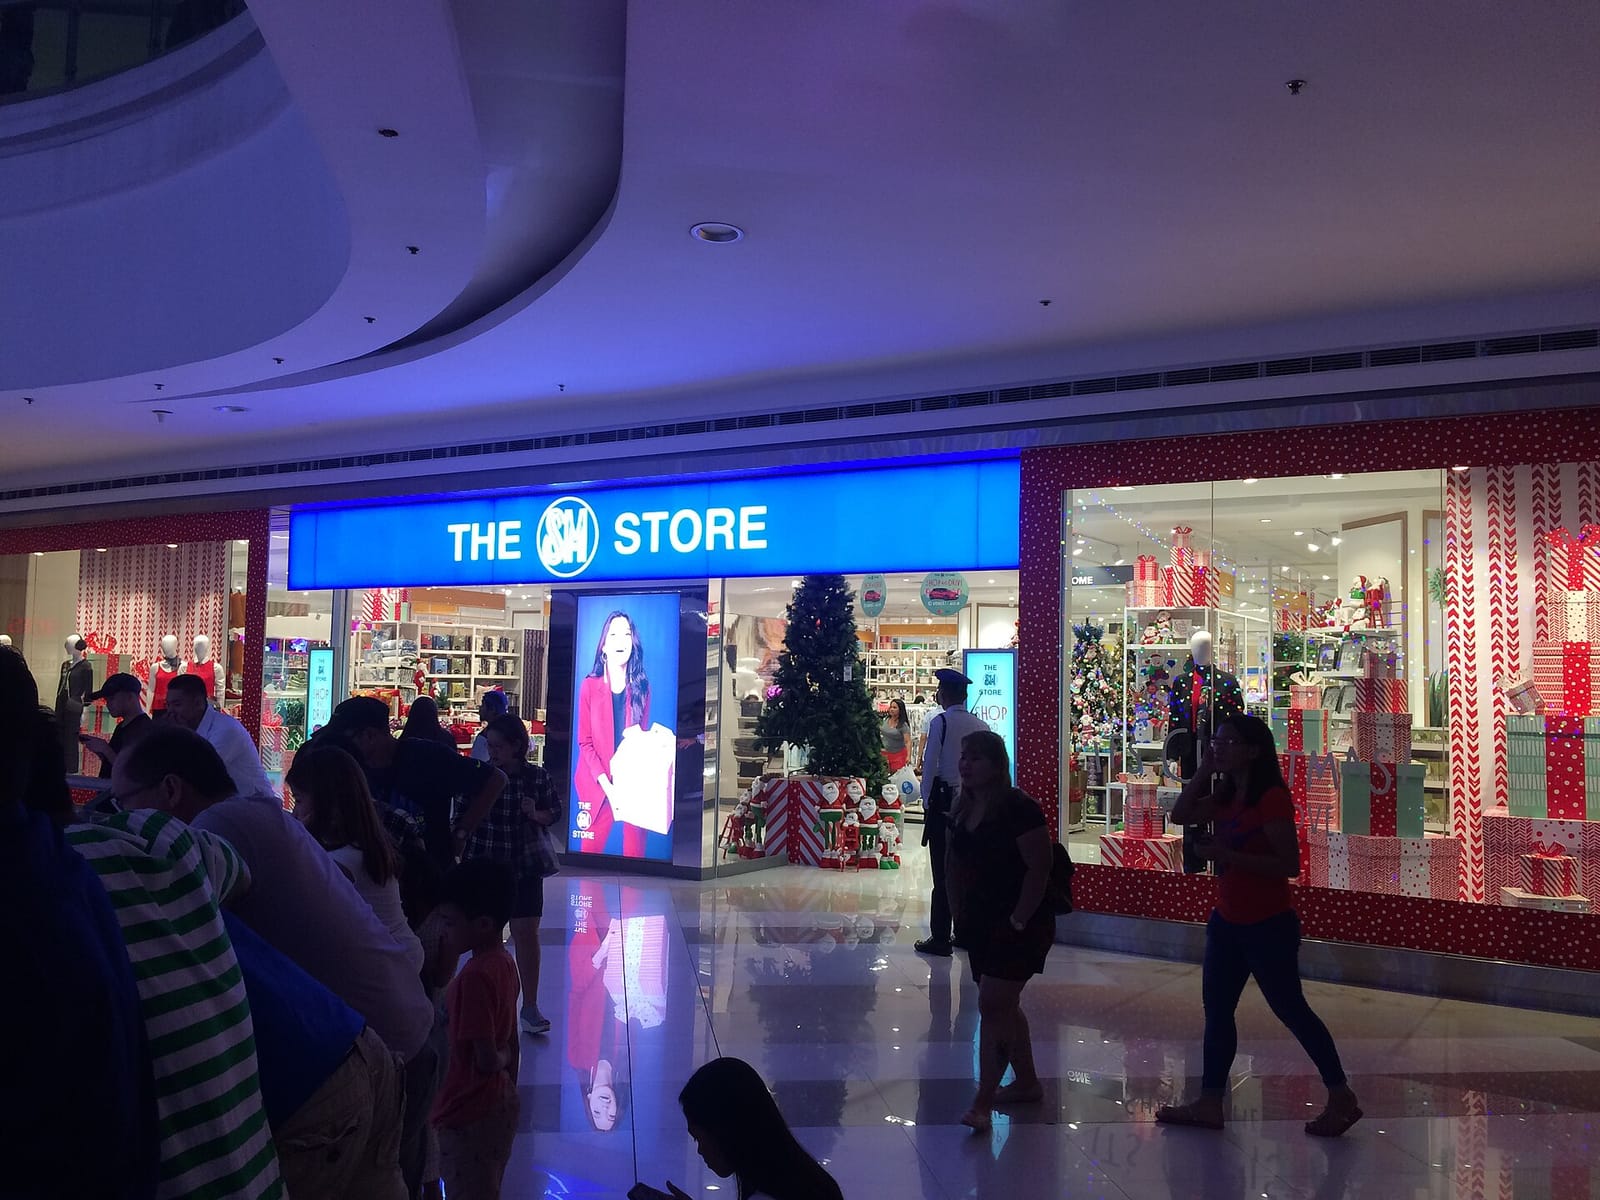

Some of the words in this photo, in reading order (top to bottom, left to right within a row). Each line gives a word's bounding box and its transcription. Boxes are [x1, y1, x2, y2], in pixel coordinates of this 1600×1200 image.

[448, 520, 522, 562] THE
[540, 504, 590, 568] SM
[613, 505, 768, 555] STORE
[1072, 576, 1094, 585] OME
[975, 705, 1008, 720] SHOP
[577, 801, 593, 810] THE
[572, 830, 595, 840] STORE
